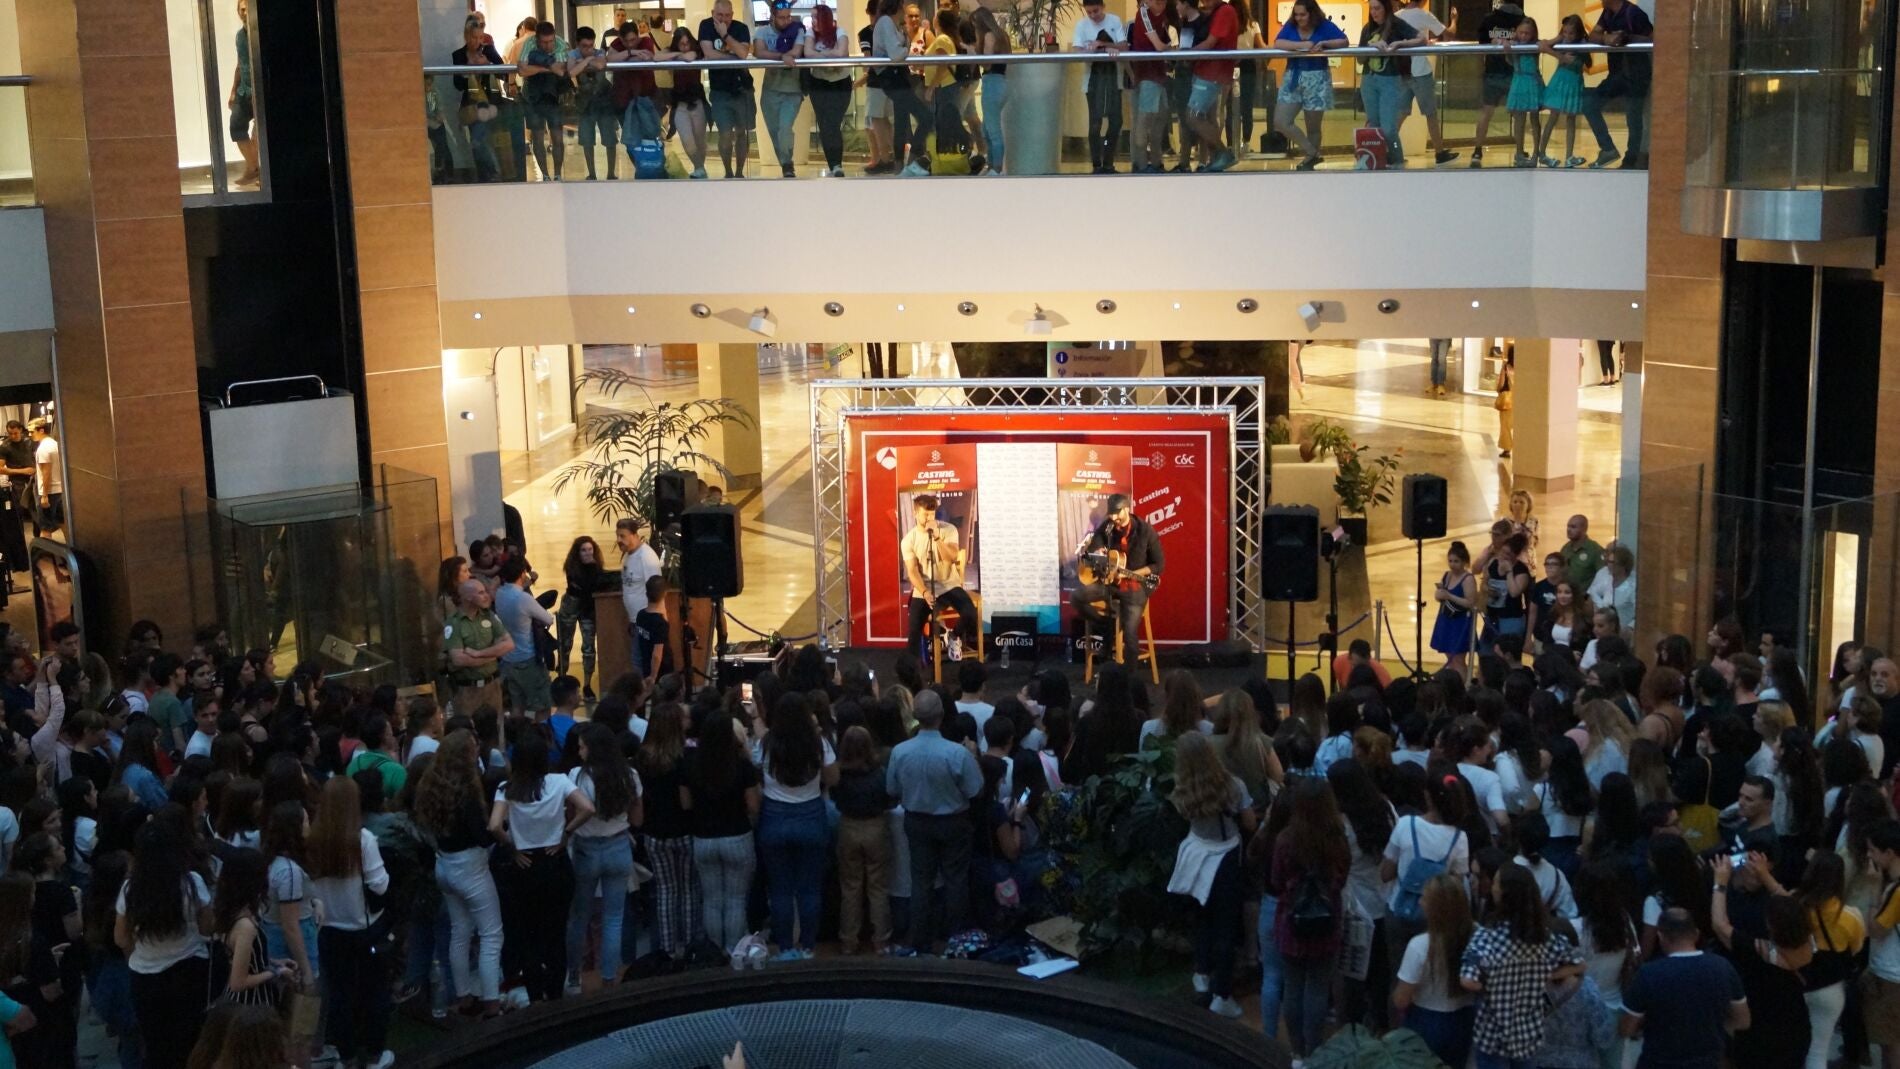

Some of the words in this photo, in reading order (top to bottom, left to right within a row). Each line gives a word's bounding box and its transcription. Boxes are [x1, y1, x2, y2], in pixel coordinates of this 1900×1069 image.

[1175, 453, 1195, 465] C&C
[918, 470, 955, 479] CASTING
[1076, 470, 1112, 479] CASTING
[1138, 486, 1170, 505] casting
